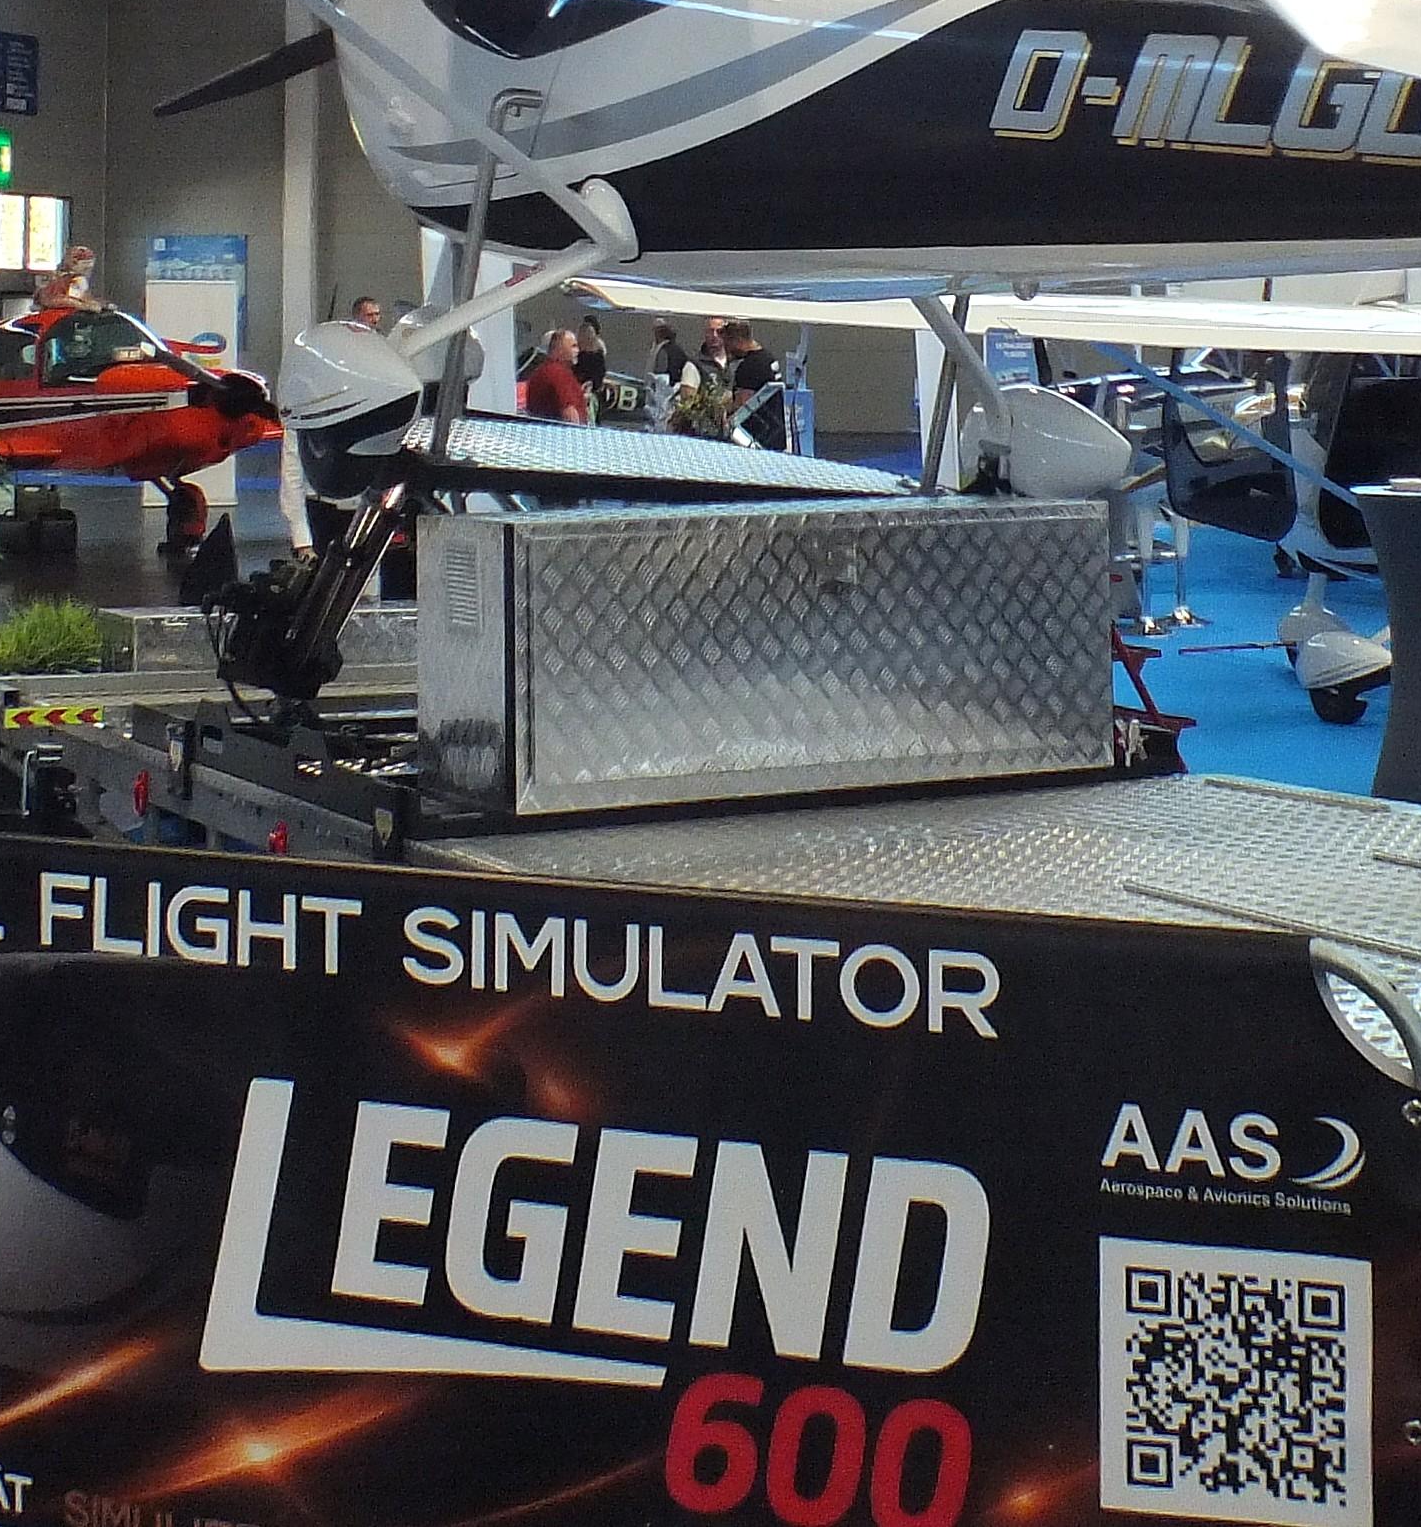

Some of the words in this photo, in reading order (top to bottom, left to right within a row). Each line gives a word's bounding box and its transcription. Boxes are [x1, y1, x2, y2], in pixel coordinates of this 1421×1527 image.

[40, 871, 362, 976] FLIGHT
[402, 906, 1001, 1039] SIMULATOR
[1100, 1102, 1282, 1182] AAS
[1100, 1177, 1183, 1201] Aerospace
[1187, 1186, 1199, 1202] &
[1203, 1187, 1271, 1208] Avionics
[1274, 1191, 1352, 1215] Solutions
[199, 1076, 991, 1388] LEGEND
[665, 1373, 973, 1527] 600
